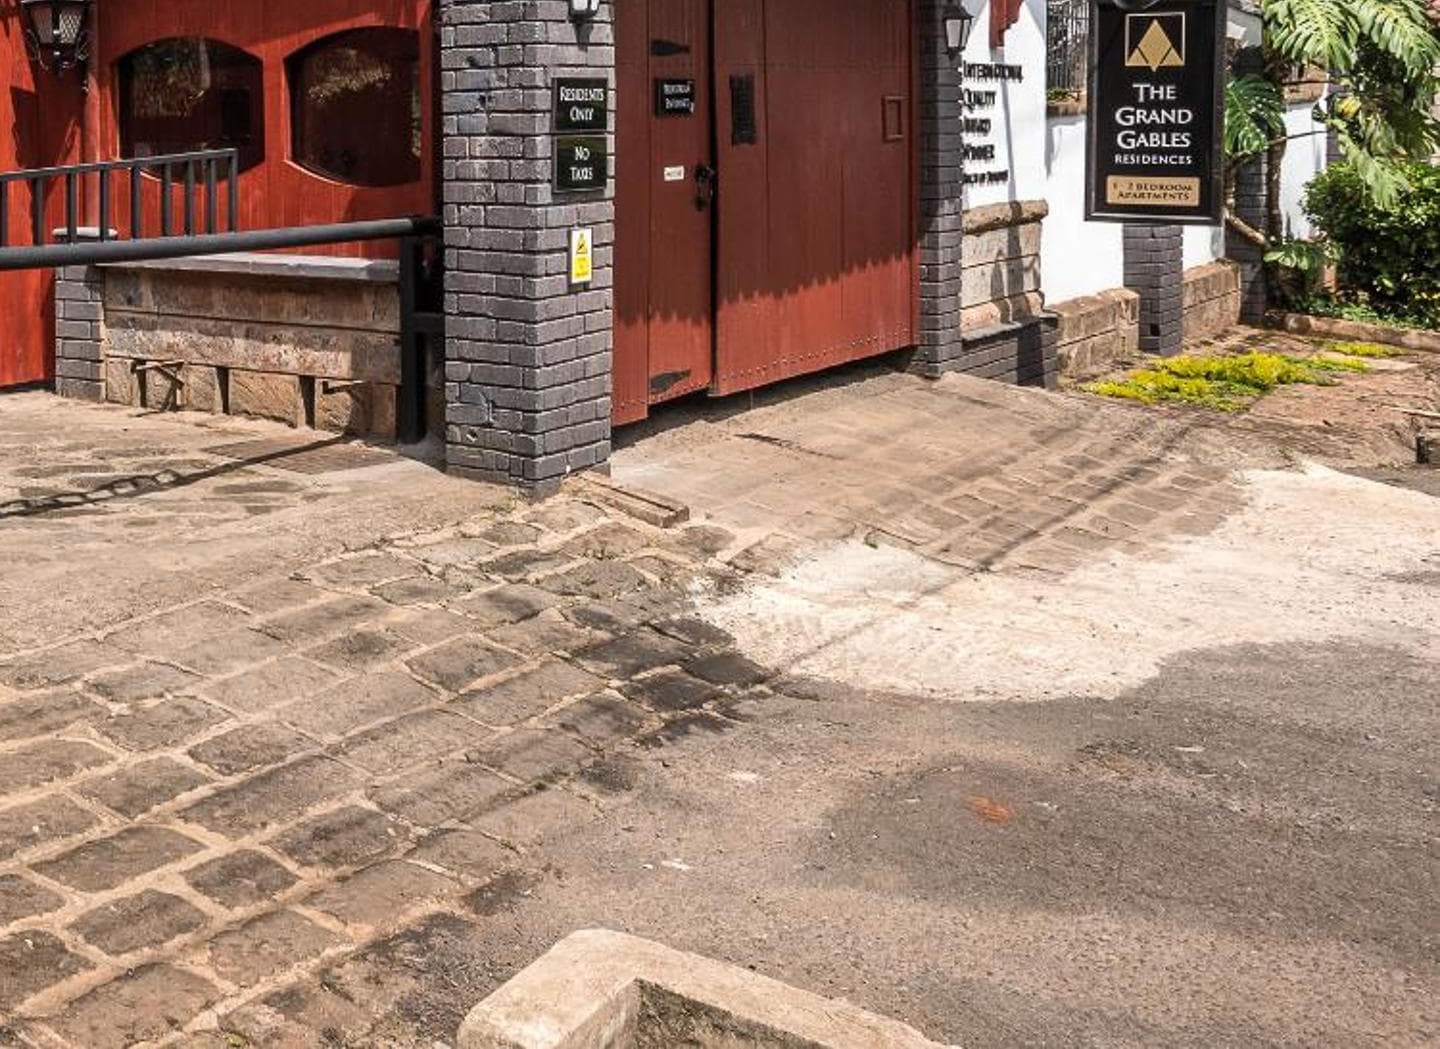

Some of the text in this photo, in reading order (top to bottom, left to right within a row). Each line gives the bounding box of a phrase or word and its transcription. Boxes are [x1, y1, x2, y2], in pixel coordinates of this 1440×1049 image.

[1132, 83, 1177, 103] THE
[1115, 107, 1193, 126] GRAND
[1116, 130, 1192, 149] GABLES
[1114, 153, 1193, 165] RESIDENCES
